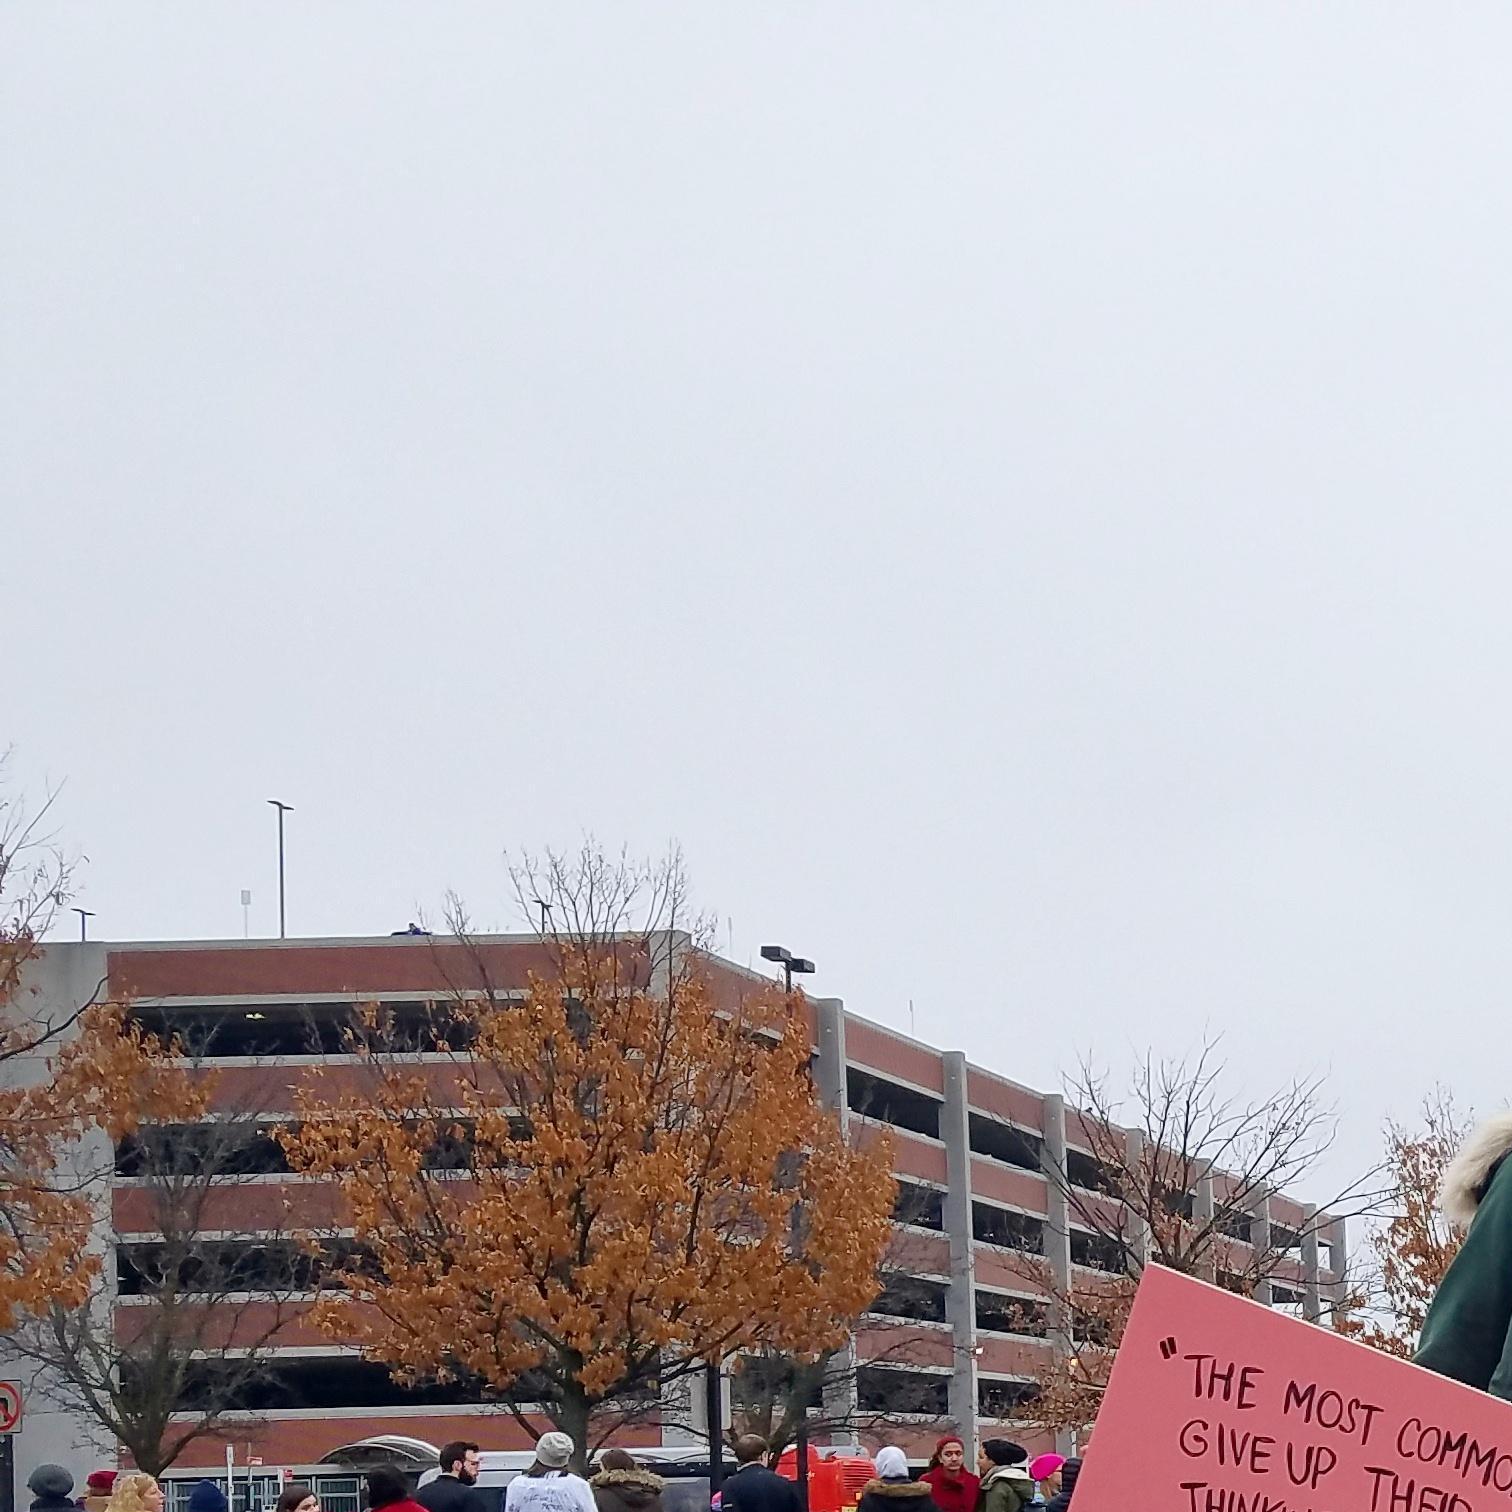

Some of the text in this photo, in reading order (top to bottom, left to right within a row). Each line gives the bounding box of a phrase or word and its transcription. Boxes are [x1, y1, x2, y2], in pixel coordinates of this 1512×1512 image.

[1160, 1337, 1264, 1409] "THE
[1284, 1381, 1384, 1445] MOST
[1180, 1420, 1276, 1473] GIVE
[1287, 1445, 1336, 1489] UP
